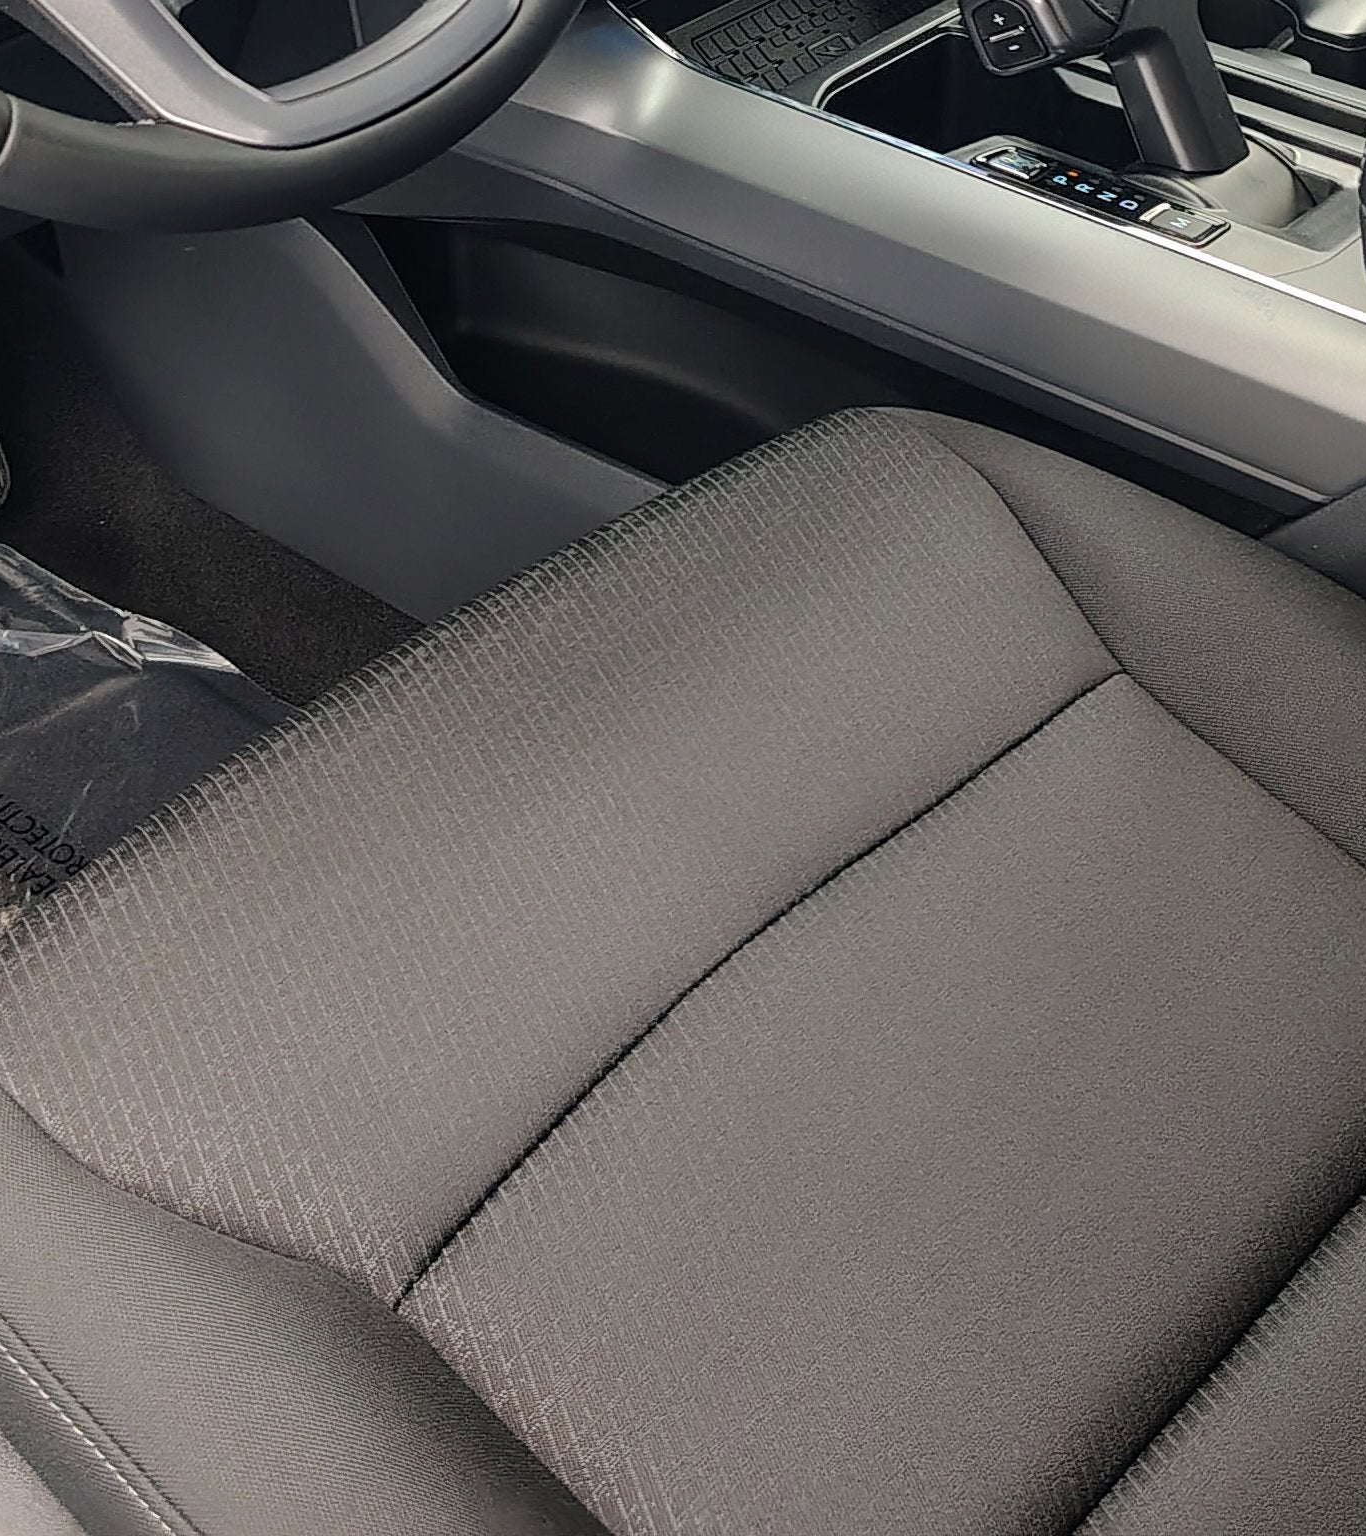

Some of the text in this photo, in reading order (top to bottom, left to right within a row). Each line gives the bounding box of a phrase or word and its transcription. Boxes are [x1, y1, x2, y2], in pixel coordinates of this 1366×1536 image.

[1052, 175, 1139, 211] P R N D
